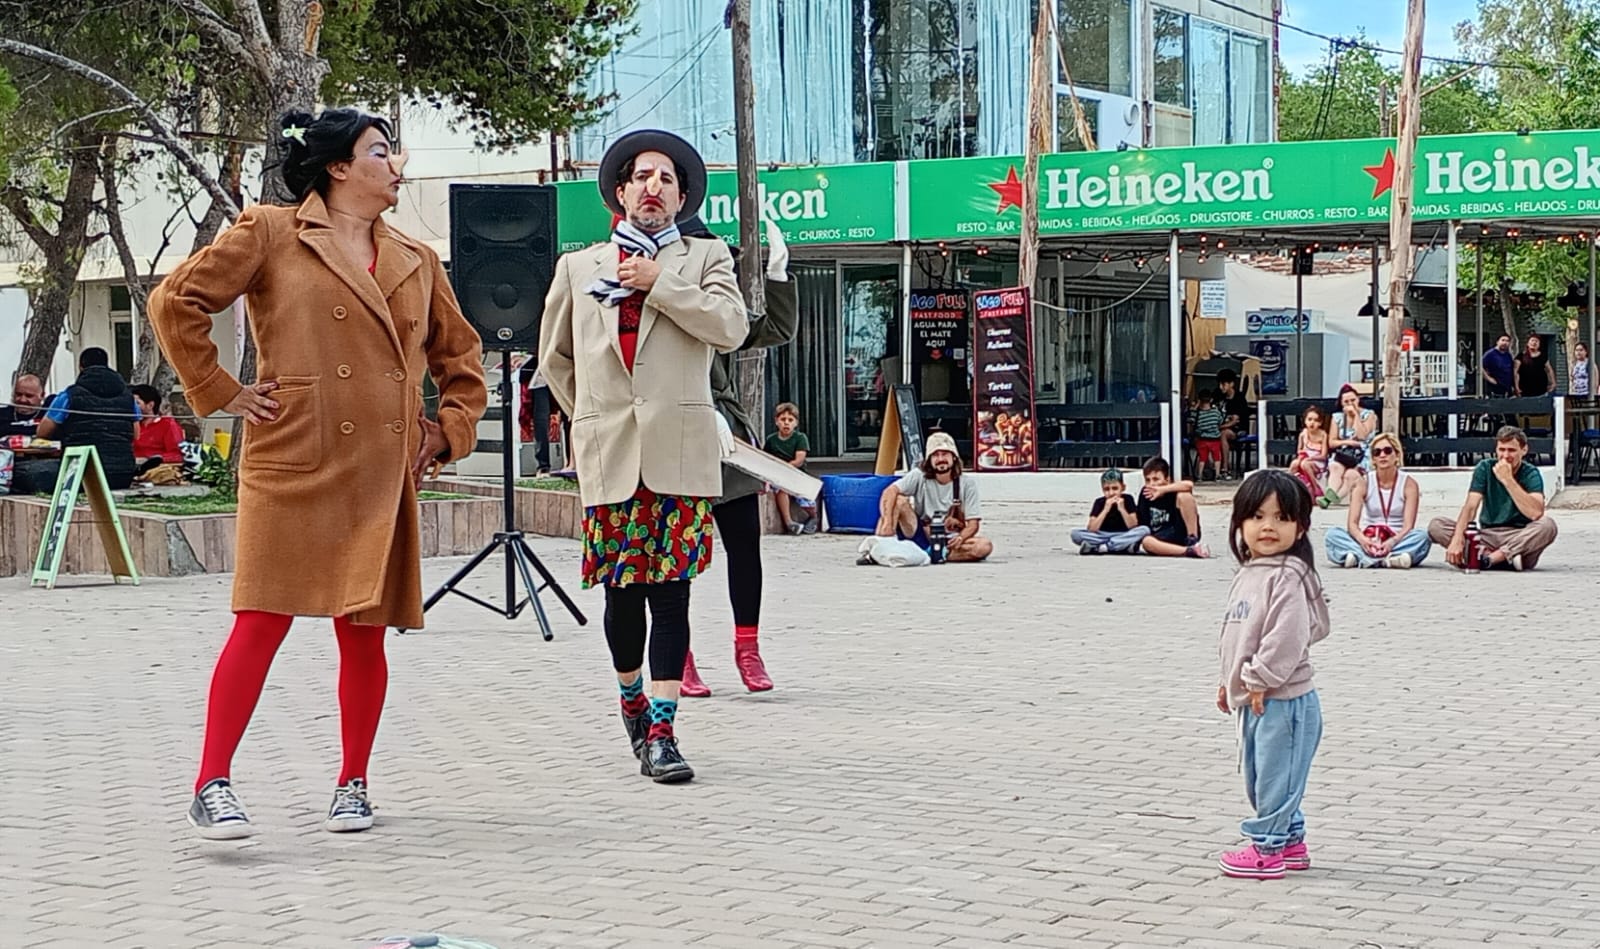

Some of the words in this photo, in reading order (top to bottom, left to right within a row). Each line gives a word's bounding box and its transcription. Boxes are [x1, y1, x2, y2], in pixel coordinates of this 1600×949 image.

[957, 222, 987, 233] RESTO
[996, 220, 1016, 231] BAR
[1082, 216, 1123, 227] BEBIDAS
[1132, 213, 1180, 226] HELADOS
[1190, 211, 1253, 223] DRUGSTORE
[1262, 208, 1314, 221] CHURROS
[1324, 206, 1357, 218] RESTO
[1367, 205, 1388, 217] BAR
[1460, 202, 1504, 214] BEBIDAS
[1515, 200, 1567, 212] HELADOS
[799, 229, 841, 240] CHURROS
[848, 227, 876, 238] RESTO
[936, 293, 966, 309] FULL
[920, 330, 928, 338] EL
[930, 330, 952, 338] MATE
